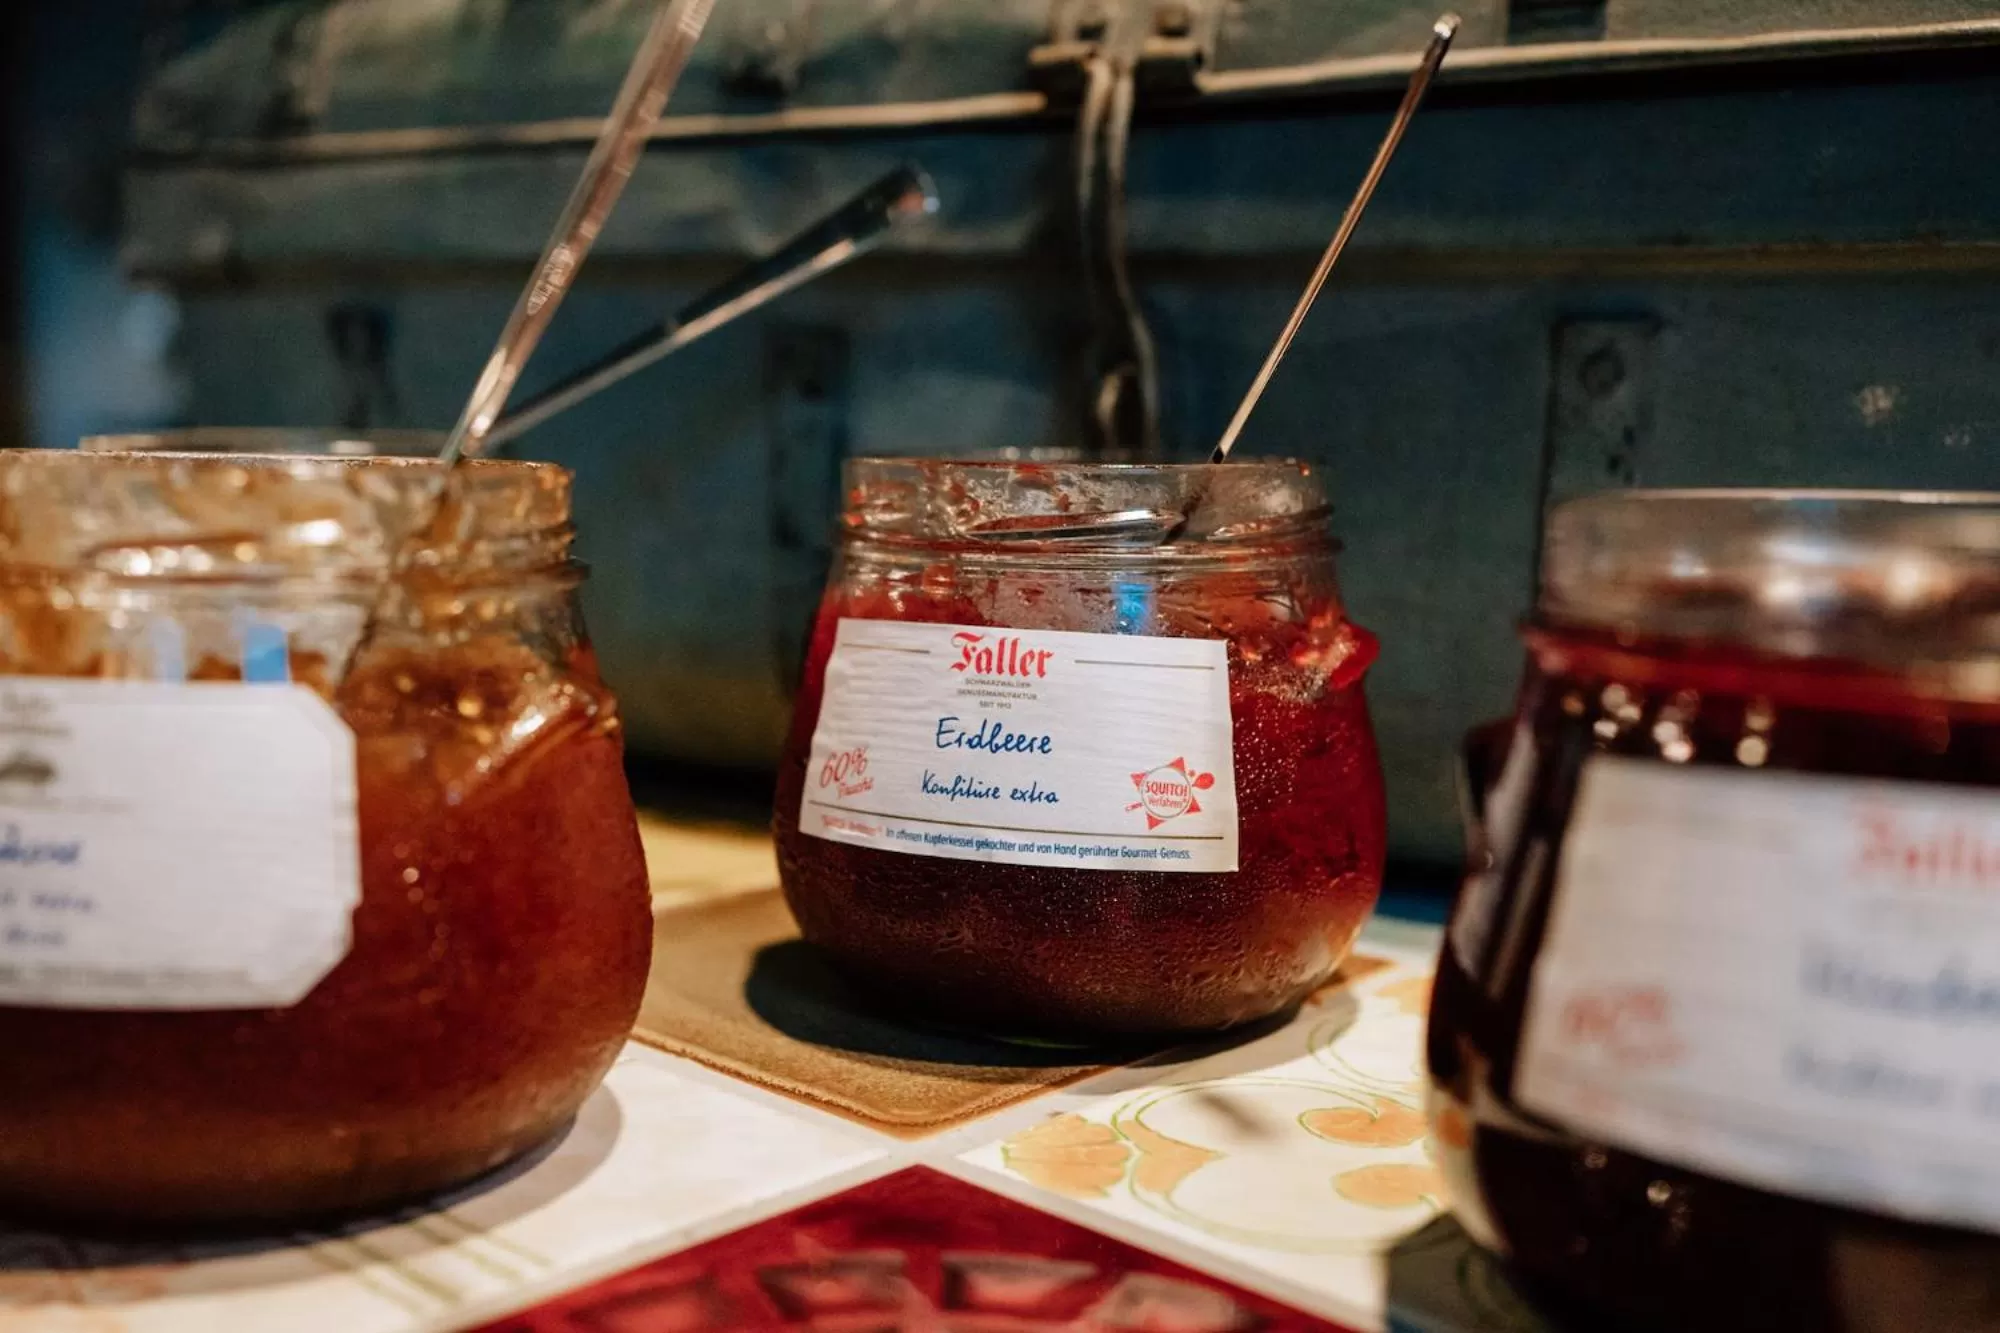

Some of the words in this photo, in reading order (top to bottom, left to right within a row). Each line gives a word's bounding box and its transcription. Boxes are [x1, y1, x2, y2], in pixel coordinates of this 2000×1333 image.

[949, 631, 1054, 678] Faller
[936, 716, 1053, 754] Erdbeere
[819, 746, 868, 789] 60%
[922, 769, 1001, 801] Konfitüre
[1009, 782, 1060, 803] extra
[924, 832, 974, 847] Kupferkessel
[976, 838, 1016, 851] gekochter
[1018, 843, 1034, 853] und
[1036, 845, 1053, 854] von
[1054, 843, 1077, 855] Hand
[1078, 845, 1119, 859] gerührter
